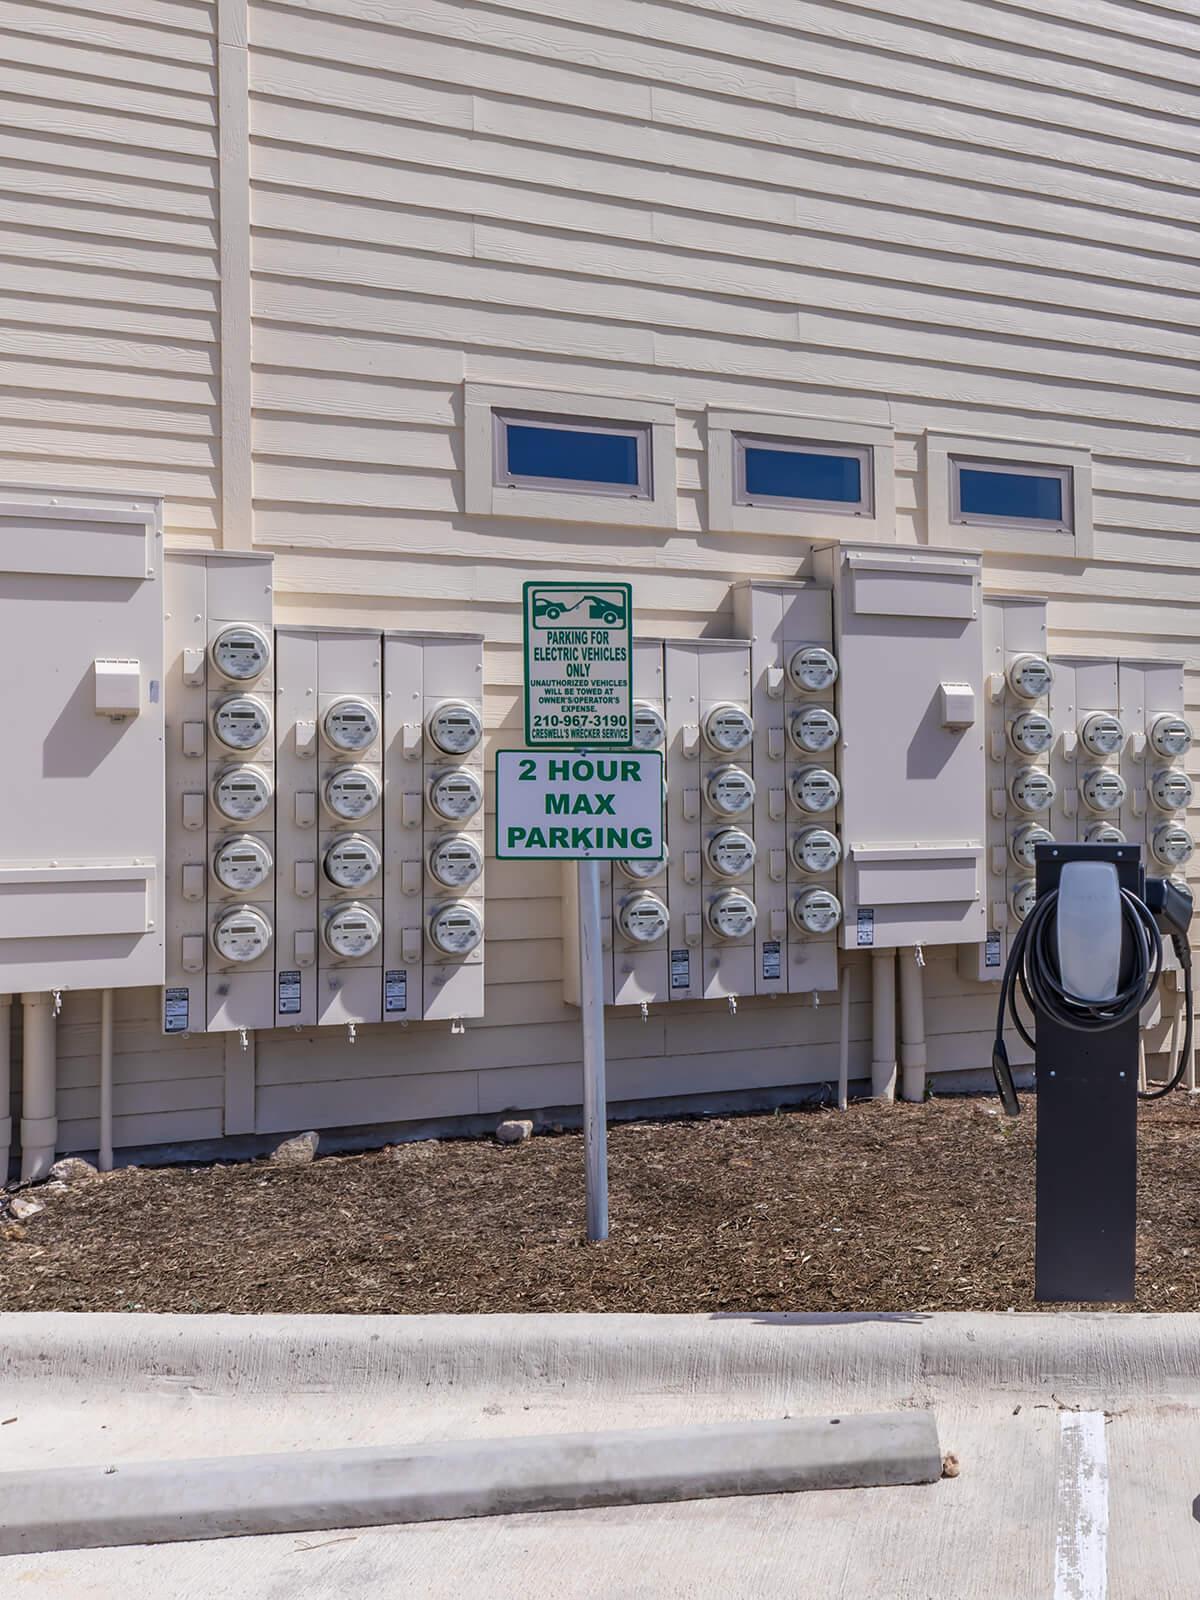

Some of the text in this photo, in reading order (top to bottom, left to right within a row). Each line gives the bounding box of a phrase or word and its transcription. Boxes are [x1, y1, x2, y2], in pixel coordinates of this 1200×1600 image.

[547, 631, 609, 645] PARKING FOR
[534, 647, 627, 661] ELECTRIC VEHICLES
[566, 663, 591, 677] ONLY
[534, 715, 627, 726] 210-967-3190
[532, 728, 628, 740] CRESWELL'S WRECKER SERVICE
[518, 760, 642, 782] 2 HOUR
[545, 793, 616, 815] MAX
[507, 827, 653, 849] PARKING
